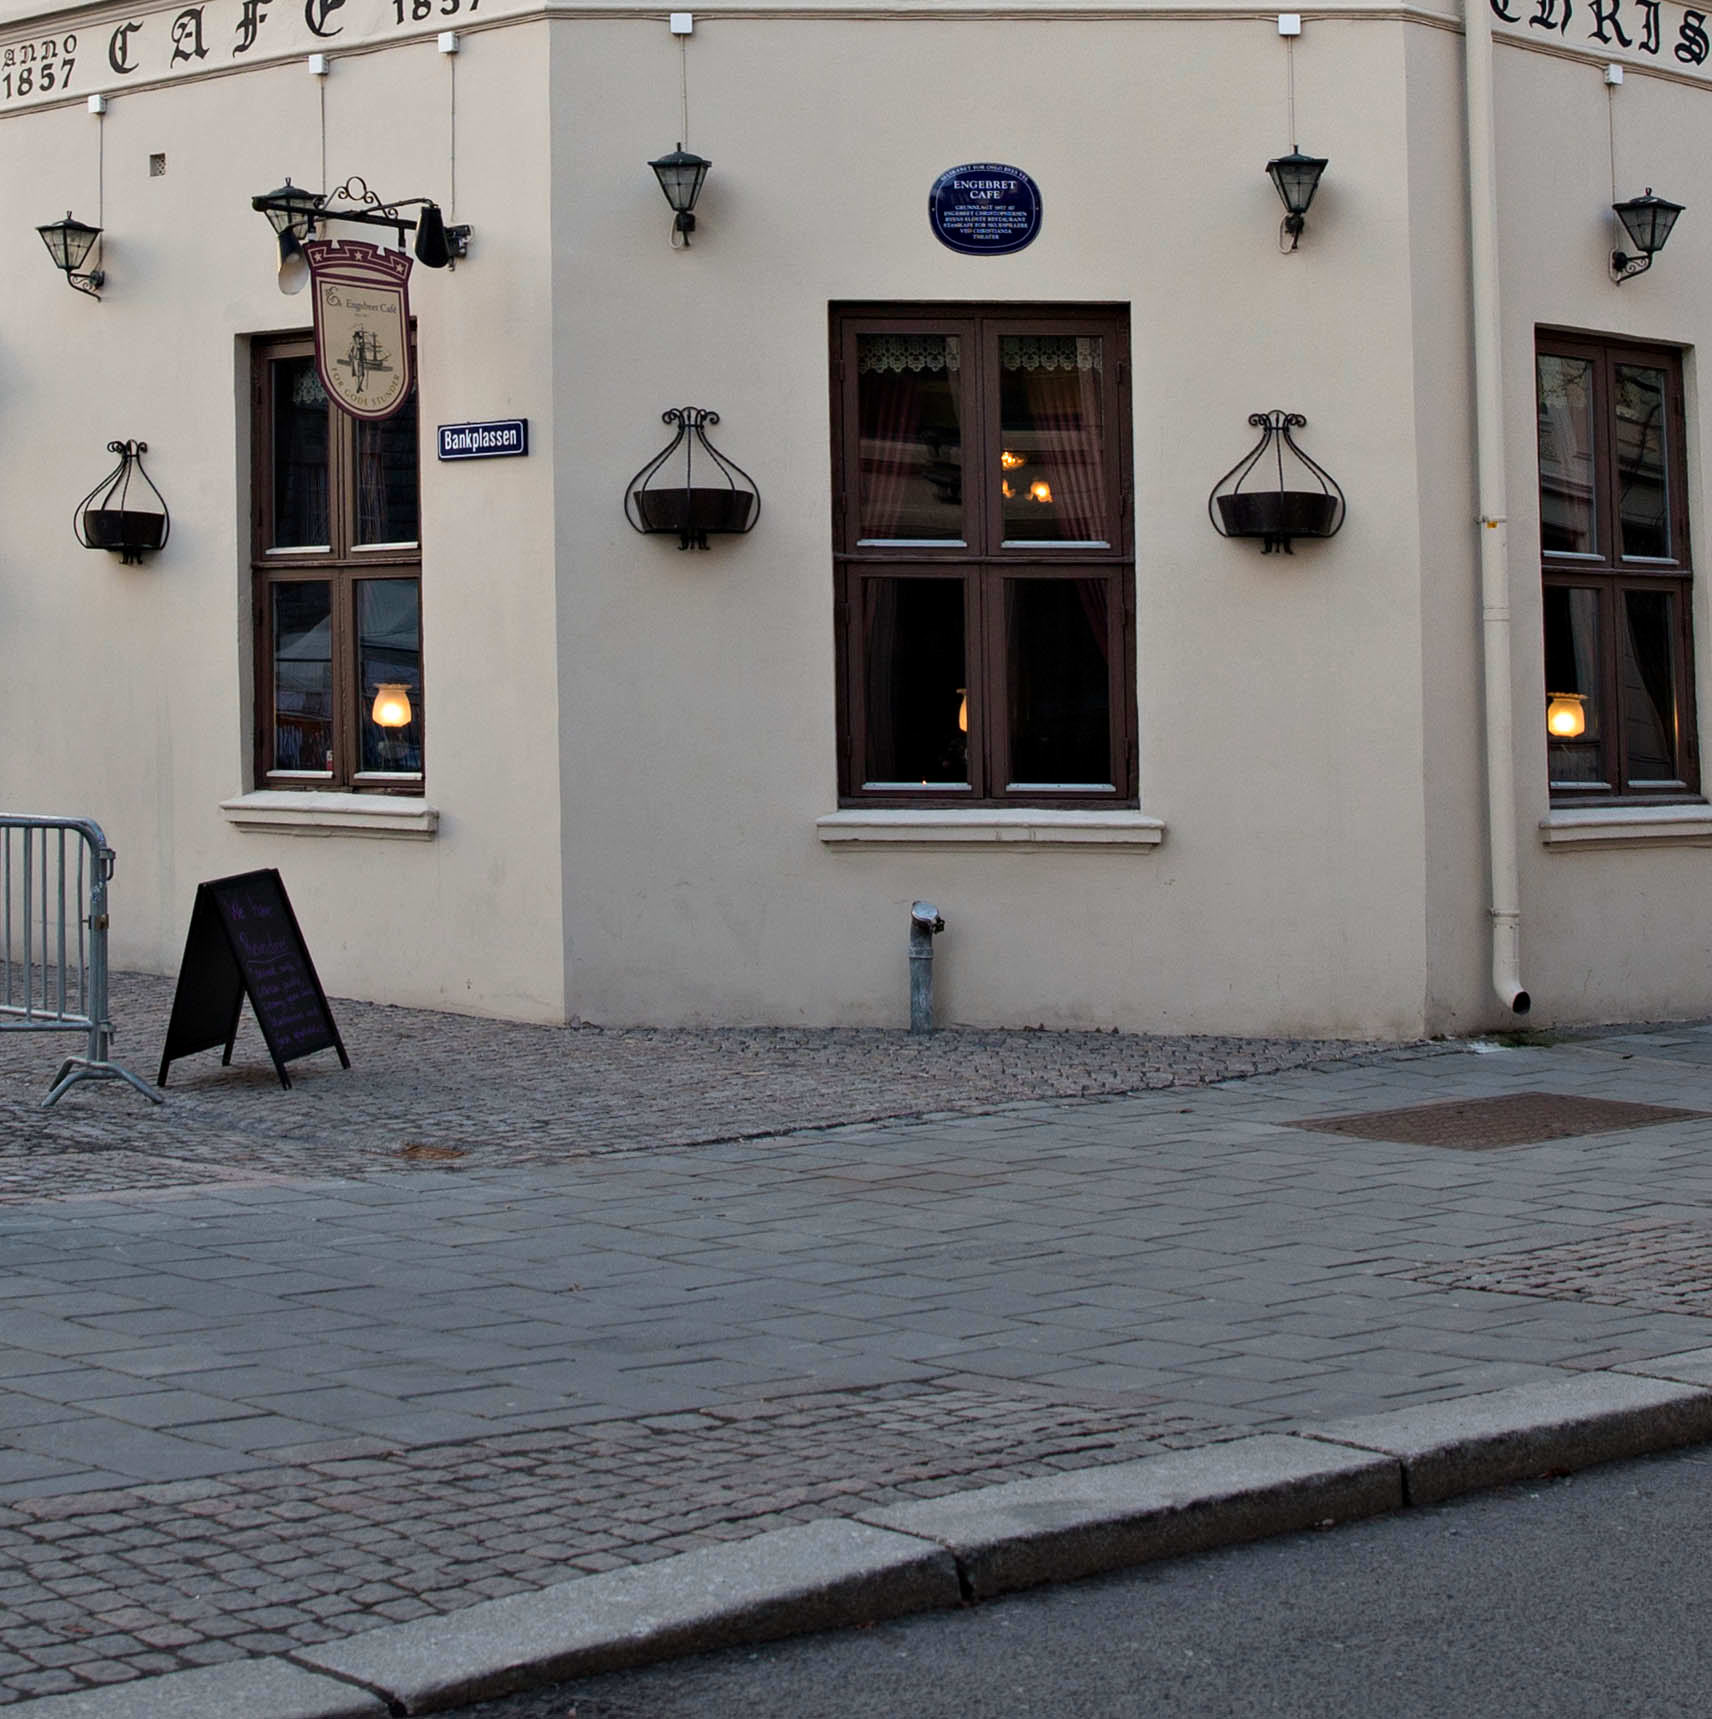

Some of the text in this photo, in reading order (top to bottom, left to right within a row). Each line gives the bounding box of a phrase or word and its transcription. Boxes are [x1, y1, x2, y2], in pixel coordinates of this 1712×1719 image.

[2, 33, 77, 71] ANNO
[2, 57, 76, 99] 1857
[953, 180, 1017, 189] ENGEBRET
[969, 190, 1000, 199] CAFE
[444, 428, 517, 452] Bankplassen
